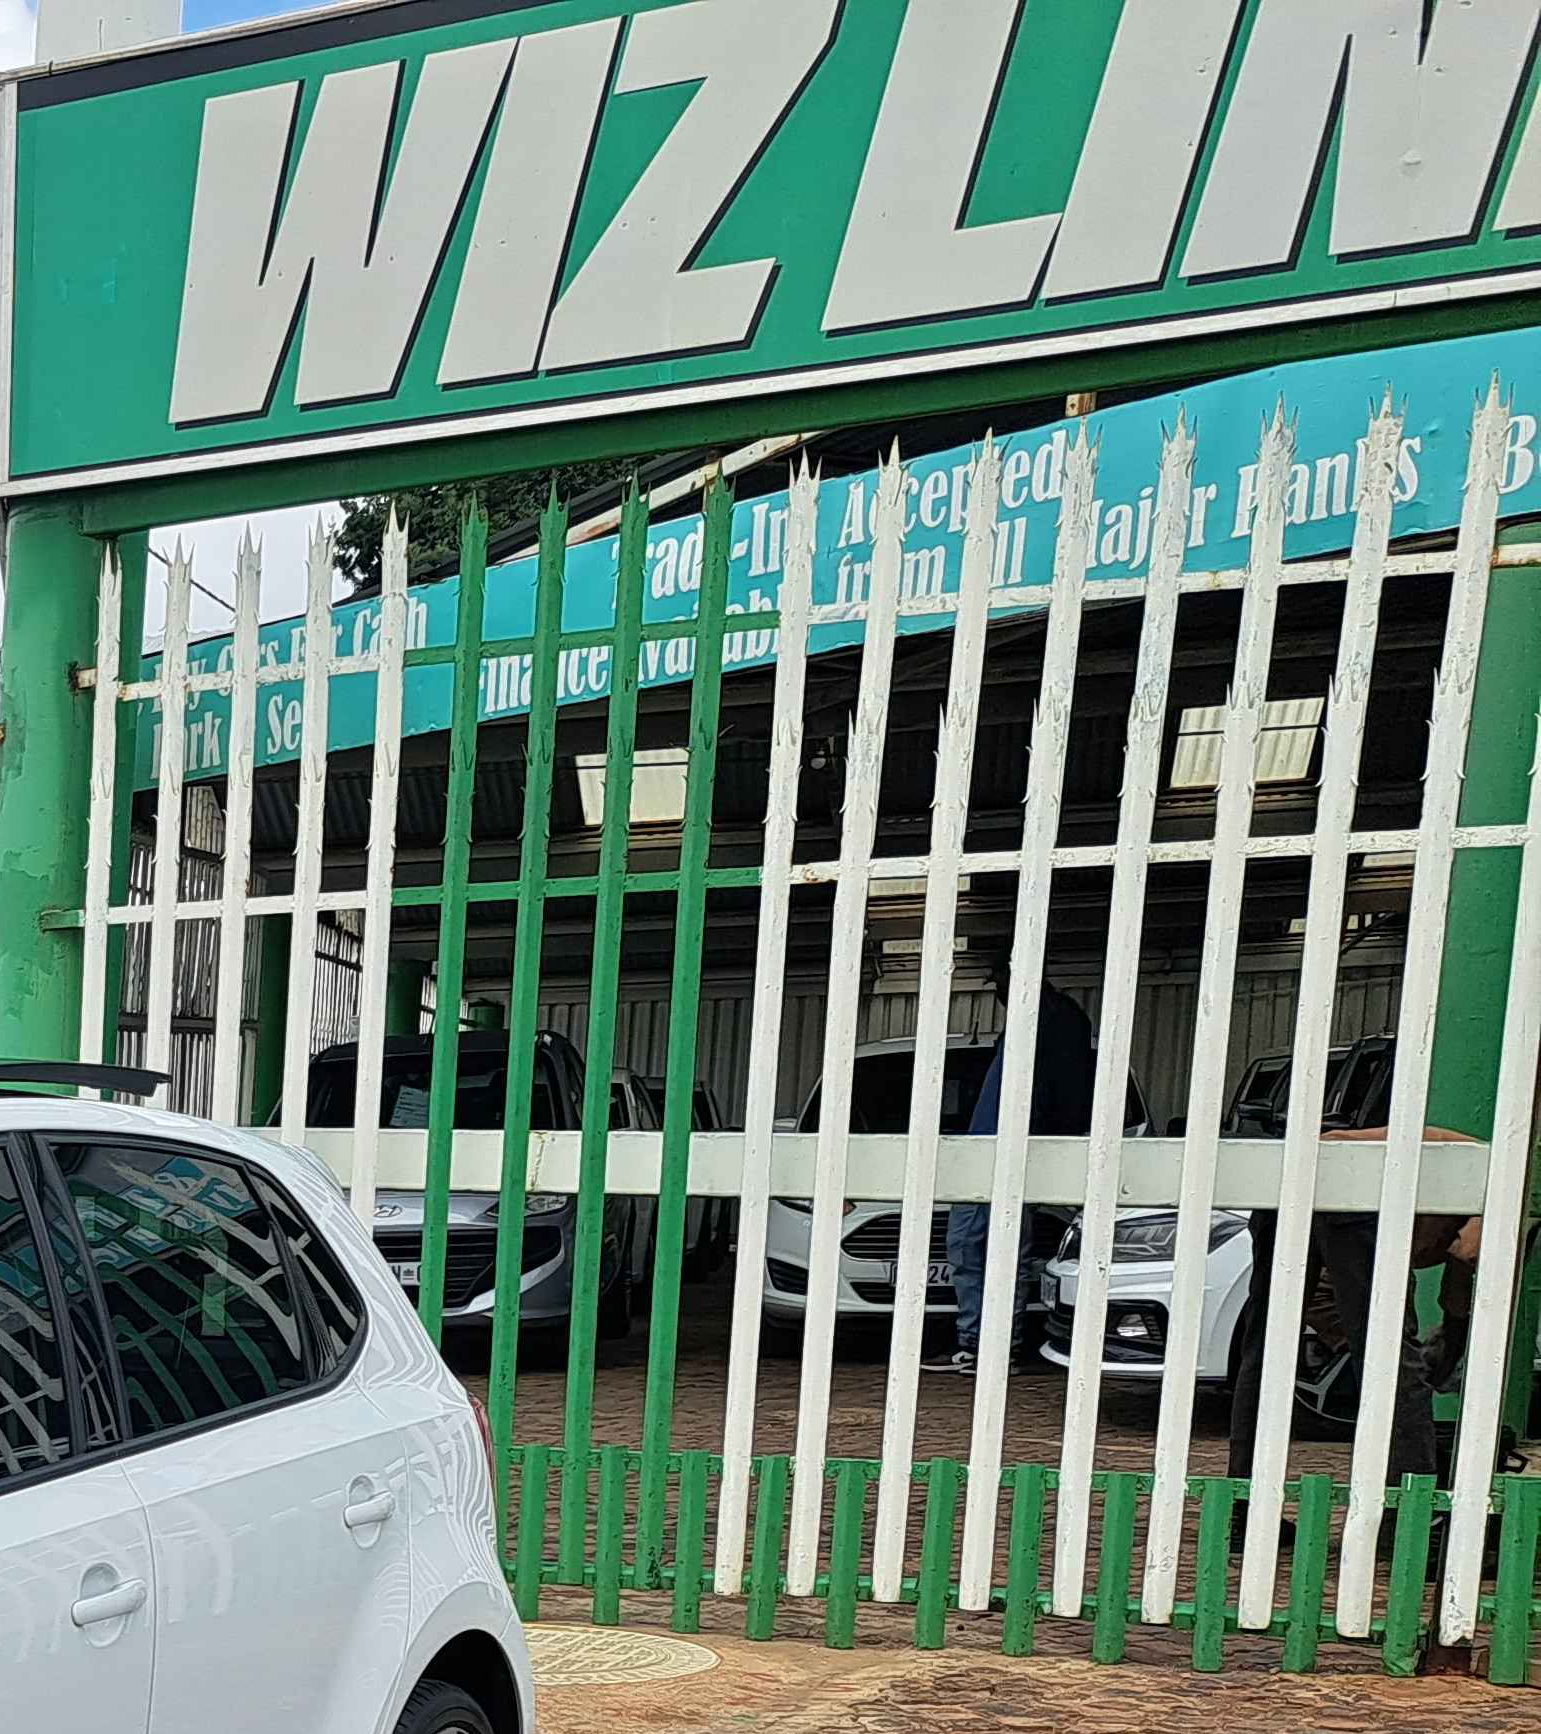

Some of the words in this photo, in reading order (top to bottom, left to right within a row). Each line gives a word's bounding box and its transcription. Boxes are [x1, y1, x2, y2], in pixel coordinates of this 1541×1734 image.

[167, 0, 844, 428] WIZ
[821, 0, 1541, 334] LIN
[479, 645, 609, 714] inace
[836, 544, 946, 604] frm
[1055, 482, 1217, 570] ajr
[612, 502, 790, 608] ad-In
[837, 429, 1067, 548] Aceped
[217, 636, 279, 695] Crs
[290, 625, 342, 672] Fr
[353, 598, 428, 659] Cah
